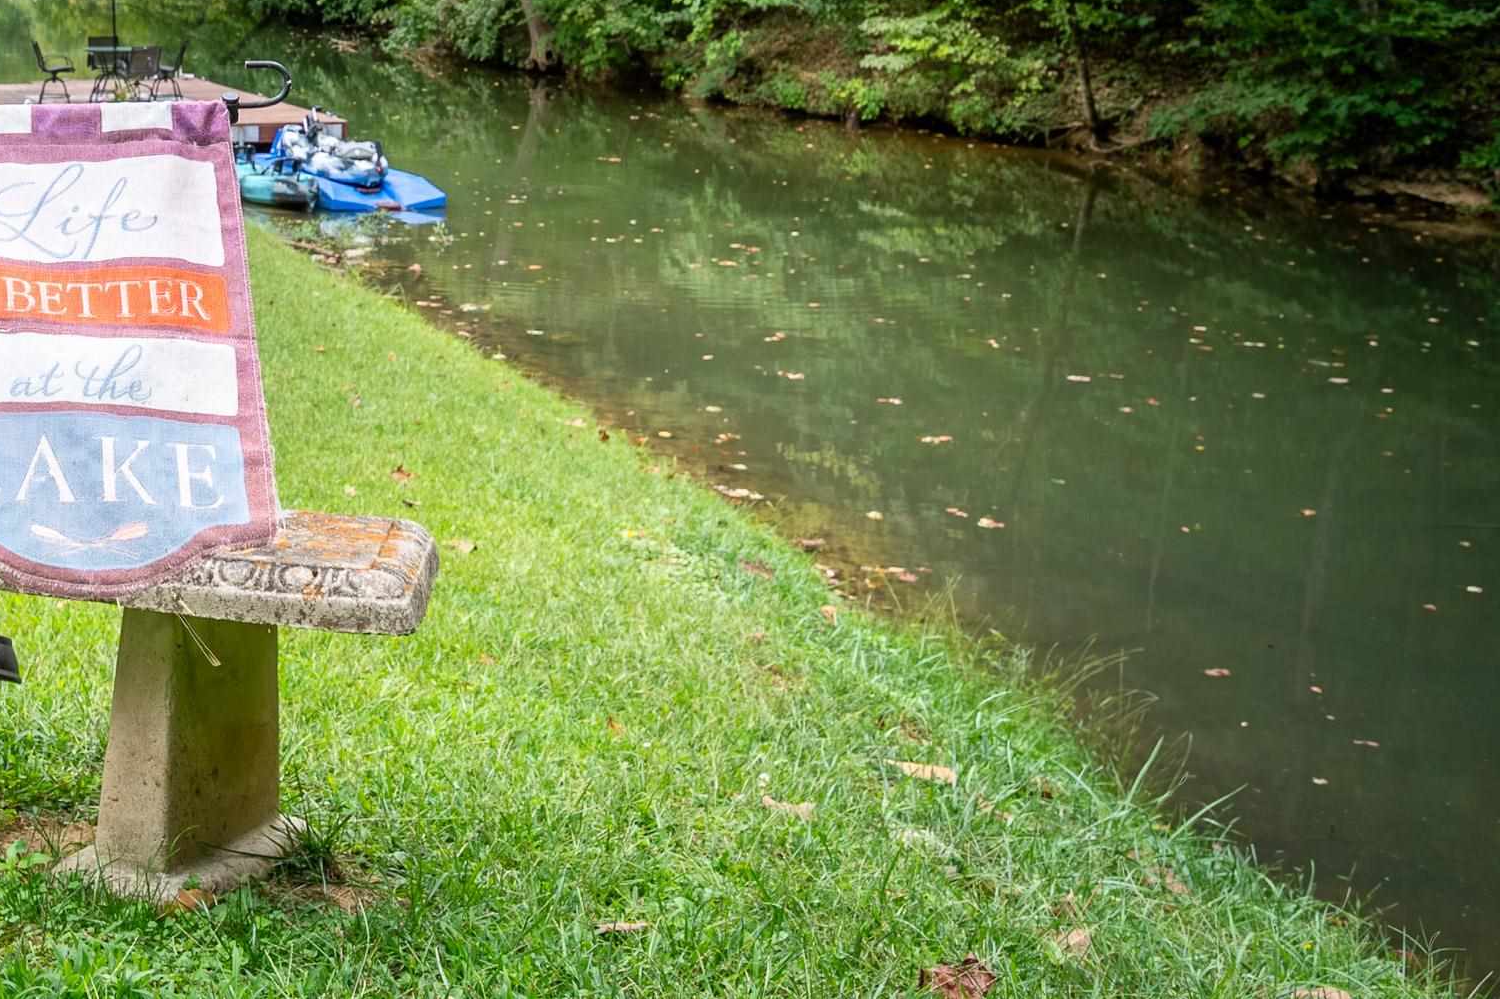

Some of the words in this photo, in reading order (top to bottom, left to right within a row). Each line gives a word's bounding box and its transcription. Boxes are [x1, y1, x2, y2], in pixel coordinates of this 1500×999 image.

[2, 276, 211, 320] BETTER
[10, 361, 63, 398] at
[74, 344, 152, 401] the
